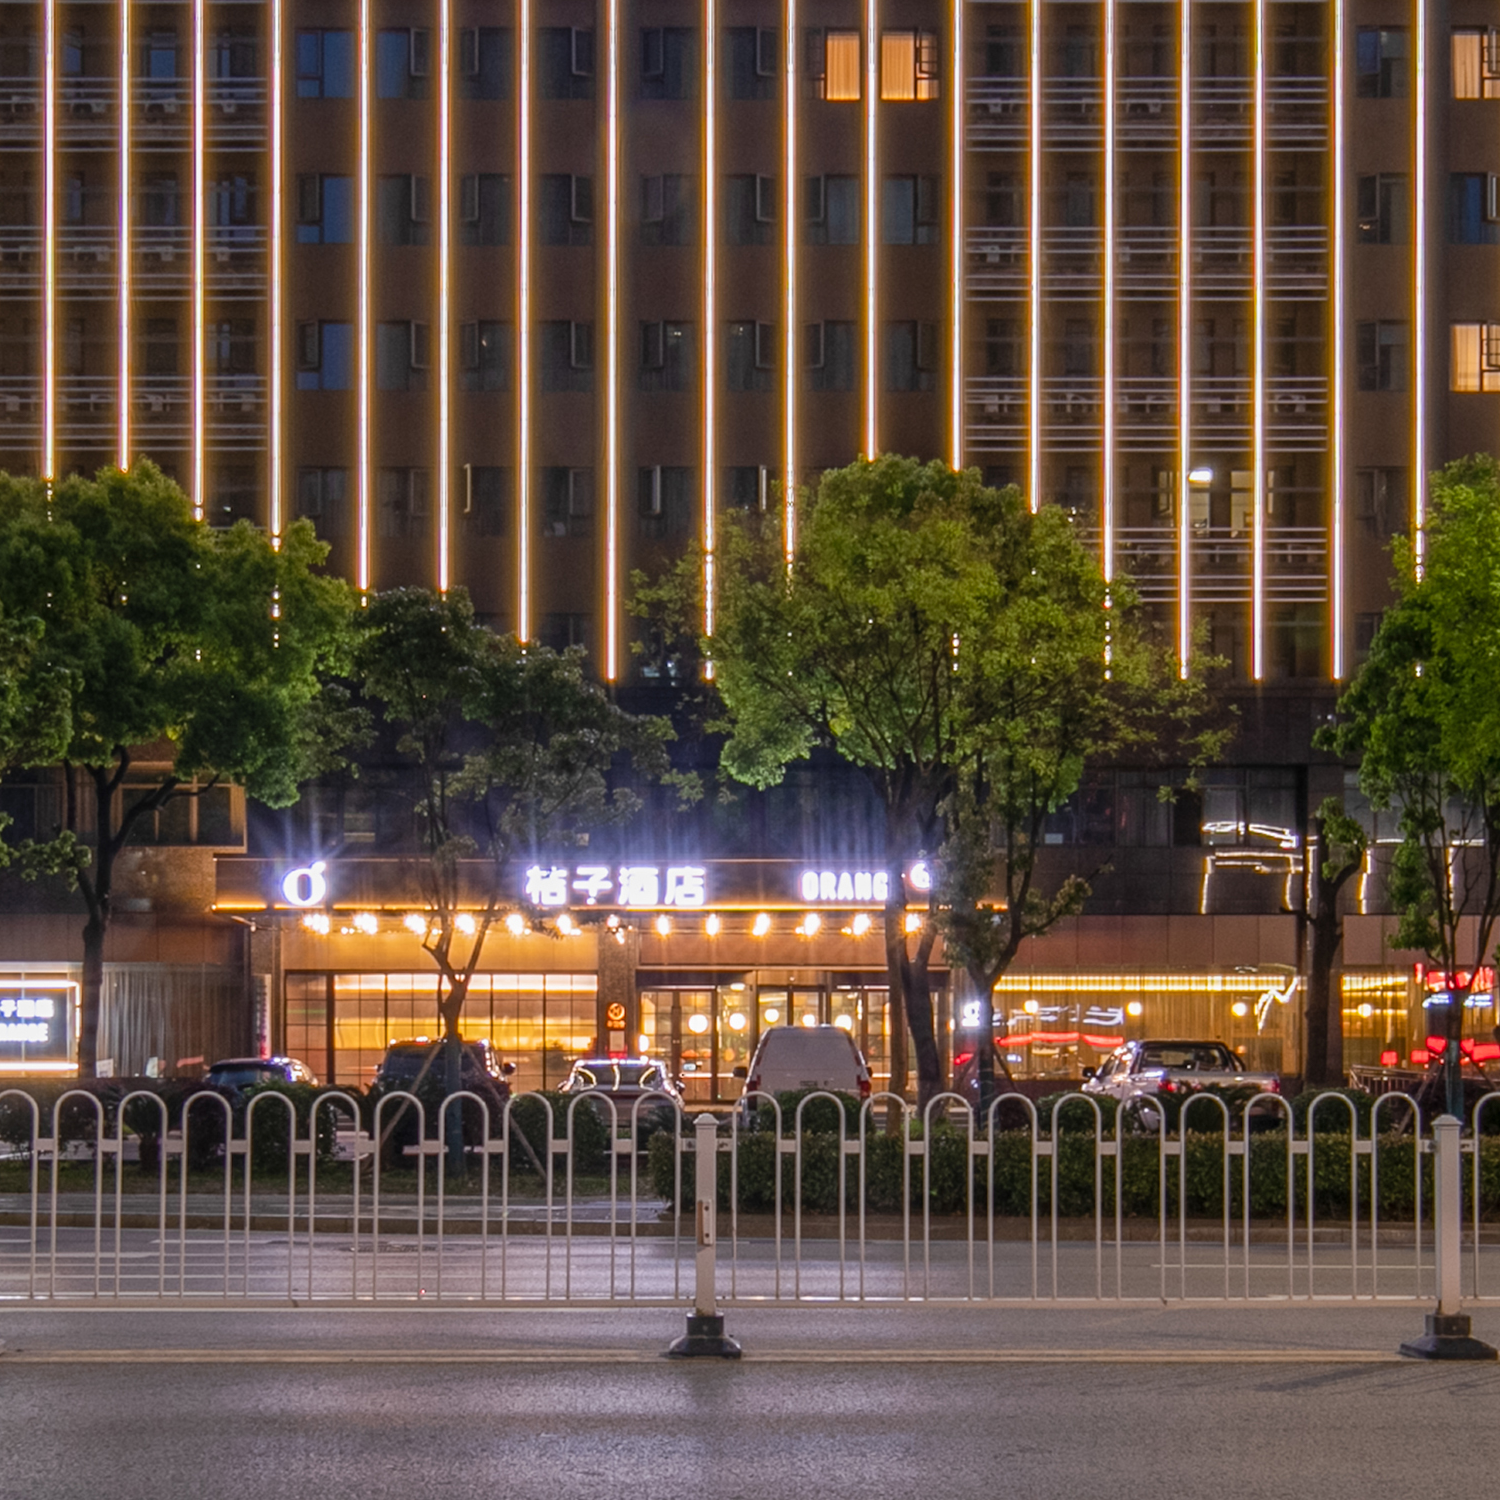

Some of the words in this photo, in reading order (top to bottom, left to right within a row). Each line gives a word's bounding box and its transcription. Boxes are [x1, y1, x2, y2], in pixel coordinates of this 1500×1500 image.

[525, 865, 706, 906] 桔子酒店
[801, 870, 901, 901] ORANG
